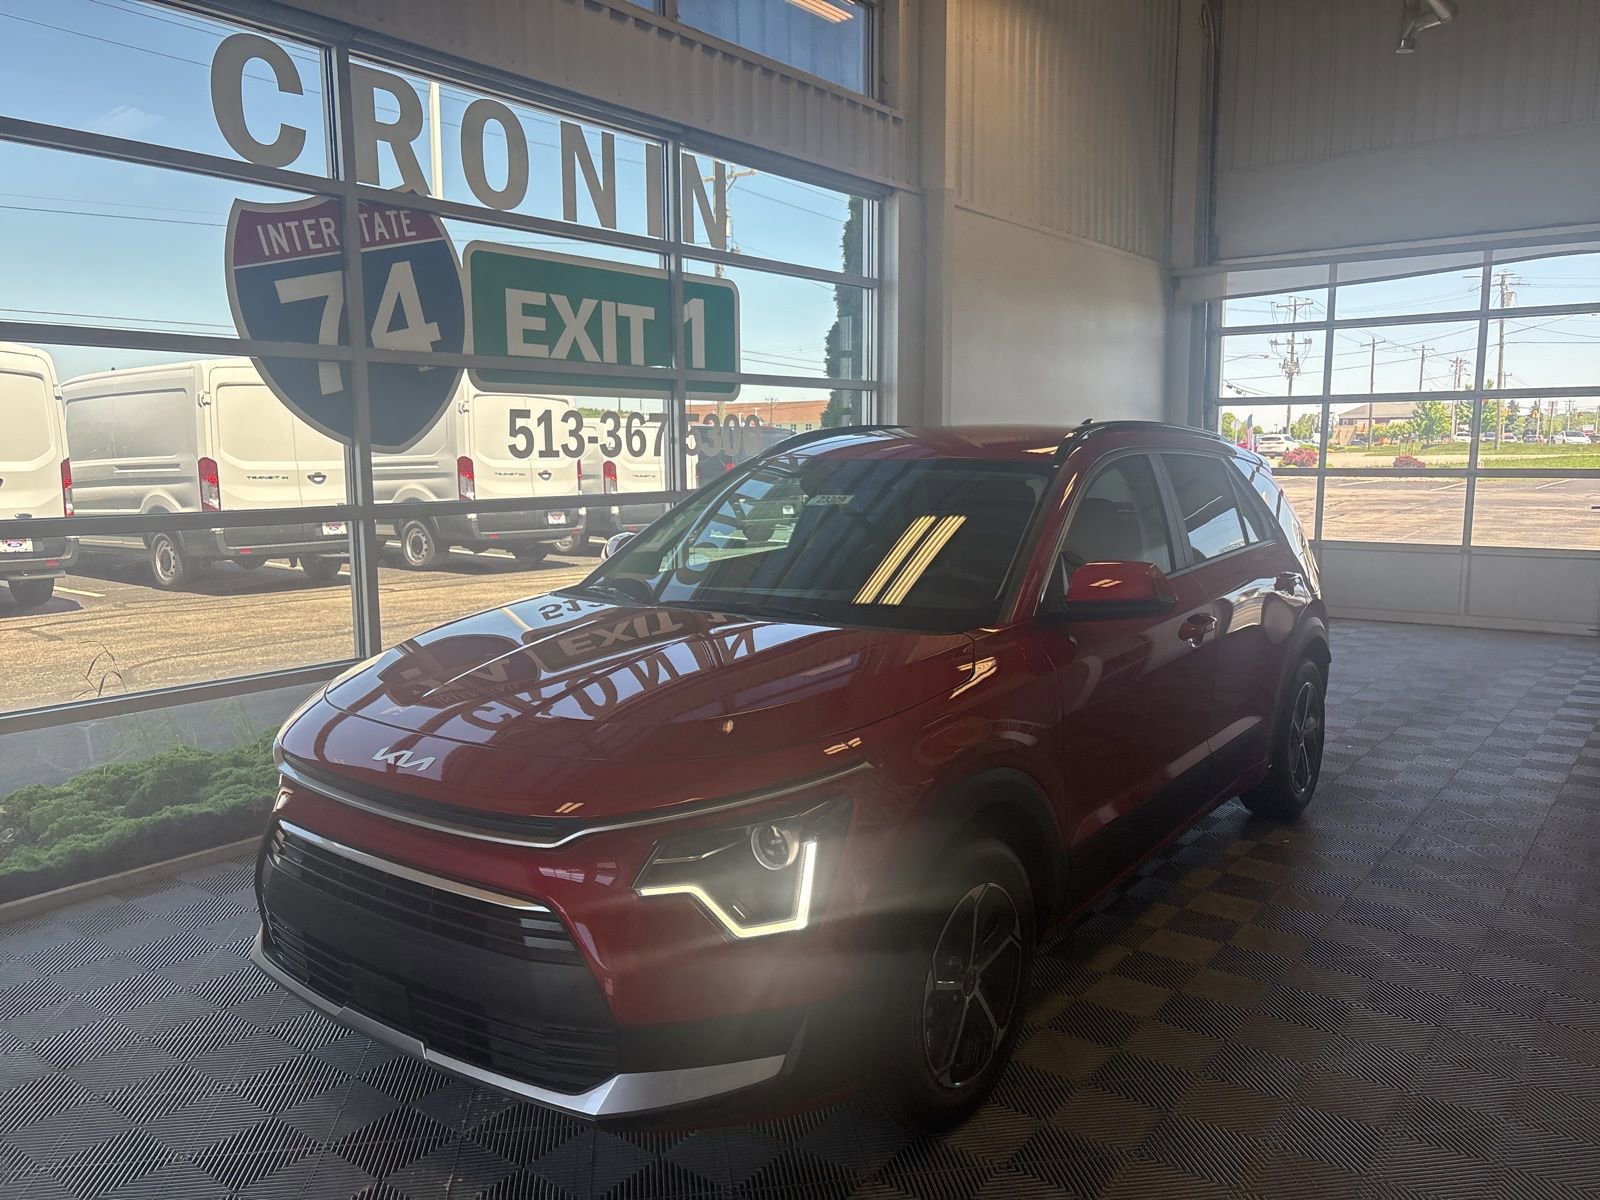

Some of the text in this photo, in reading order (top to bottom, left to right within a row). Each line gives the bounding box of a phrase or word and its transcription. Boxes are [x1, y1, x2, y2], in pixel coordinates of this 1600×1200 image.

[211, 32, 726, 250] CRONIN
[256, 209, 417, 256] INTERTATE
[274, 261, 441, 396] 74
[505, 288, 706, 369] EXIT 1
[508, 408, 762, 459] 513-3675300
